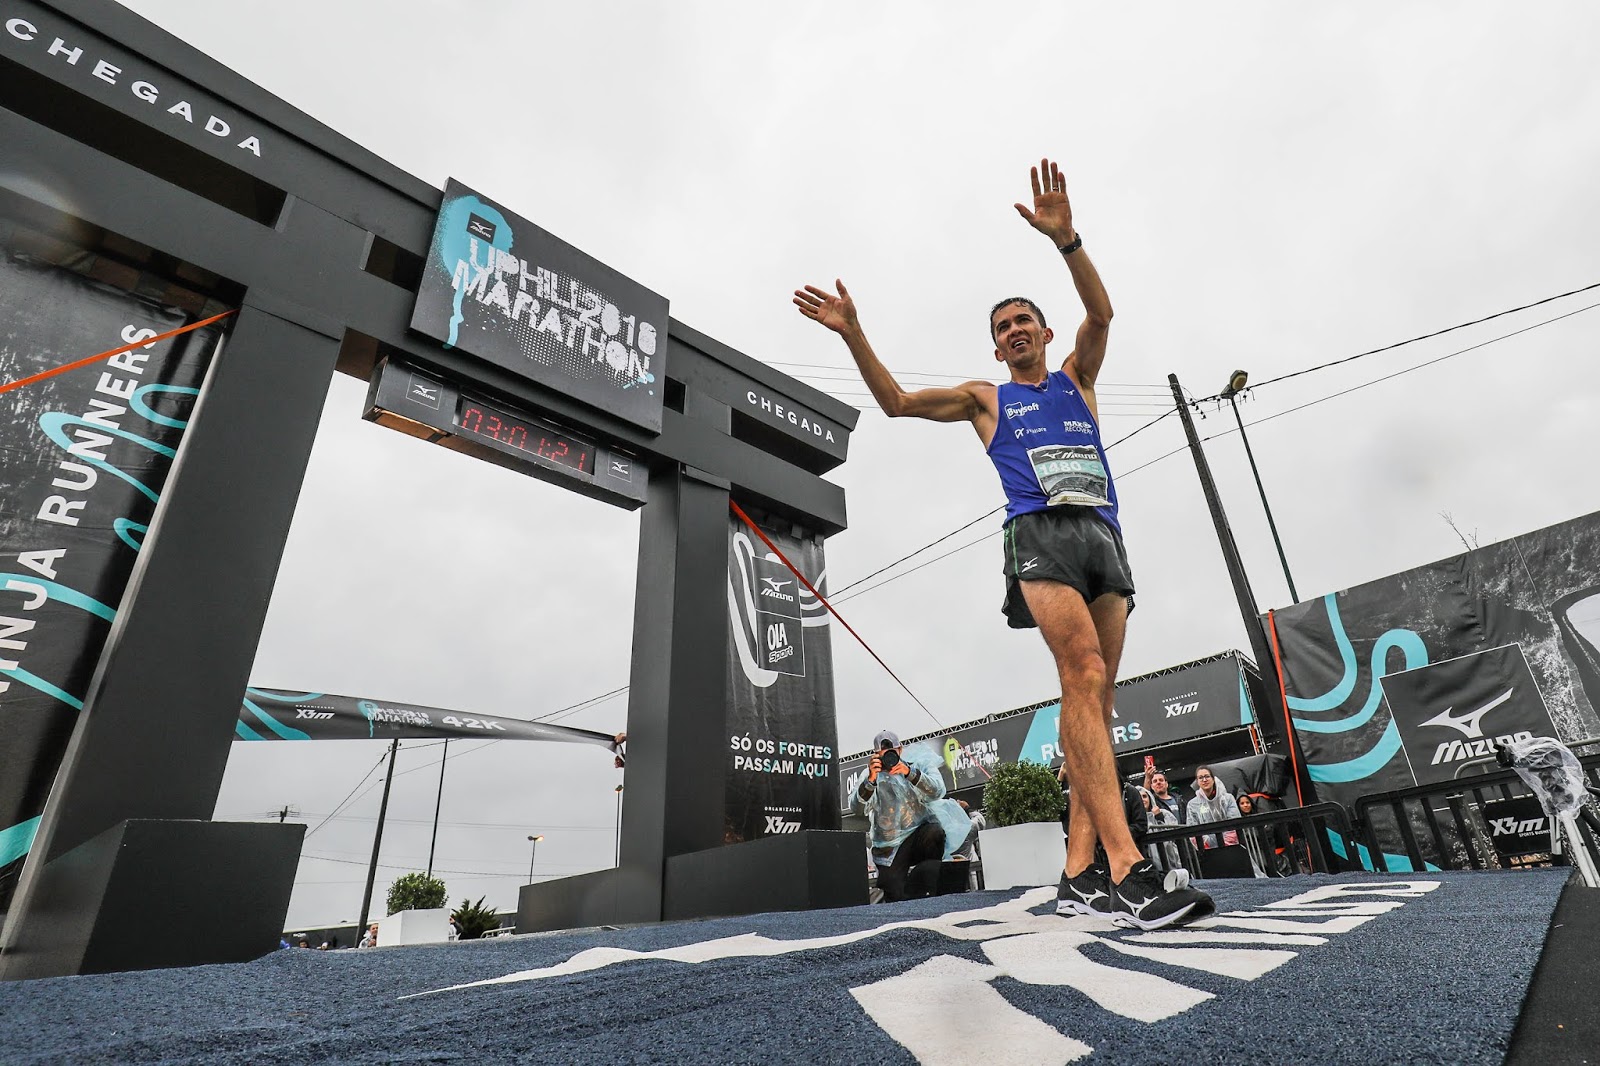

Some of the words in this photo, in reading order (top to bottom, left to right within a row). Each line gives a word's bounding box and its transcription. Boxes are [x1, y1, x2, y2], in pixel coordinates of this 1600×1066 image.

[5, 18, 261, 157] CHEGADA
[451, 258, 651, 384] MARATHON
[747, 391, 835, 443] CHEGADA
[462, 408, 586, 472] 03:01:21
[1041, 460, 1082, 475] 1480
[0, 549, 67, 706] NJA
[37, 324, 158, 527] RUNNERS
[767, 622, 788, 651] OLA
[442, 716, 506, 731] 42K
[731, 732, 752, 751] SÓ
[756, 739, 775, 754] OS
[779, 741, 832, 759] FORTES
[734, 755, 794, 774] PASSAM
[797, 762, 829, 779] AQUI
